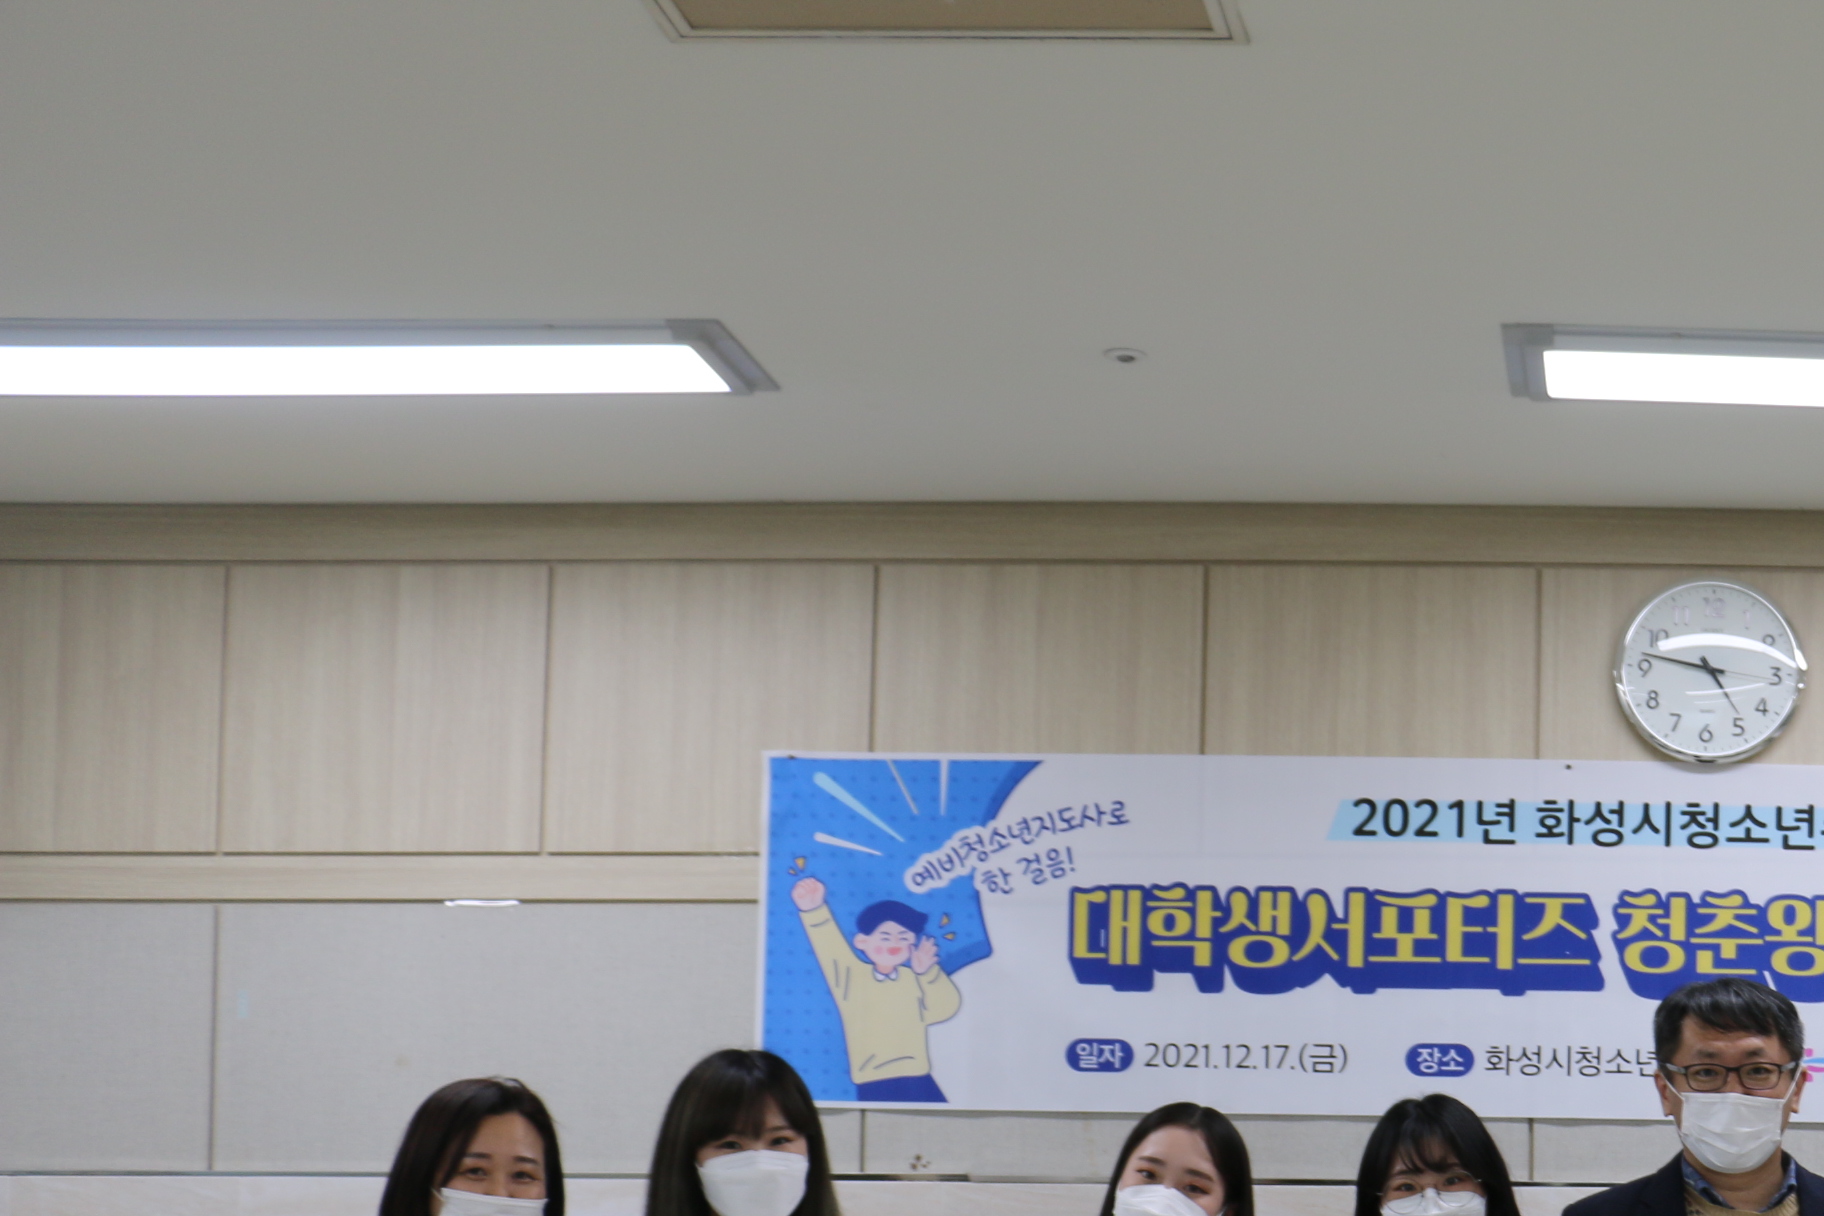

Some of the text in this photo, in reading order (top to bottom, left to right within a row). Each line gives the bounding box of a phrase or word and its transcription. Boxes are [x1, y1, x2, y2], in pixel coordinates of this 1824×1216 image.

[1672, 605, 1690, 627] 11
[1637, 658, 1652, 677] 9
[1768, 667, 1782, 685] 3
[1646, 690, 1660, 709] 8
[1754, 698, 1769, 716] 4
[1669, 713, 1682, 732] 7
[1698, 724, 1714, 742] 6
[1732, 717, 1745, 737] 5
[1351, 797, 1517, 845] 2021년
[911, 800, 1131, 888] 예비청소년지도사로
[980, 846, 1076, 895] 한 걸음!
[1071, 882, 1598, 982] 대학생서포터즈
[1075, 1042, 1348, 1073] 일자 2021.12.17.(금)
[1416, 1048, 1465, 1073] 장소
